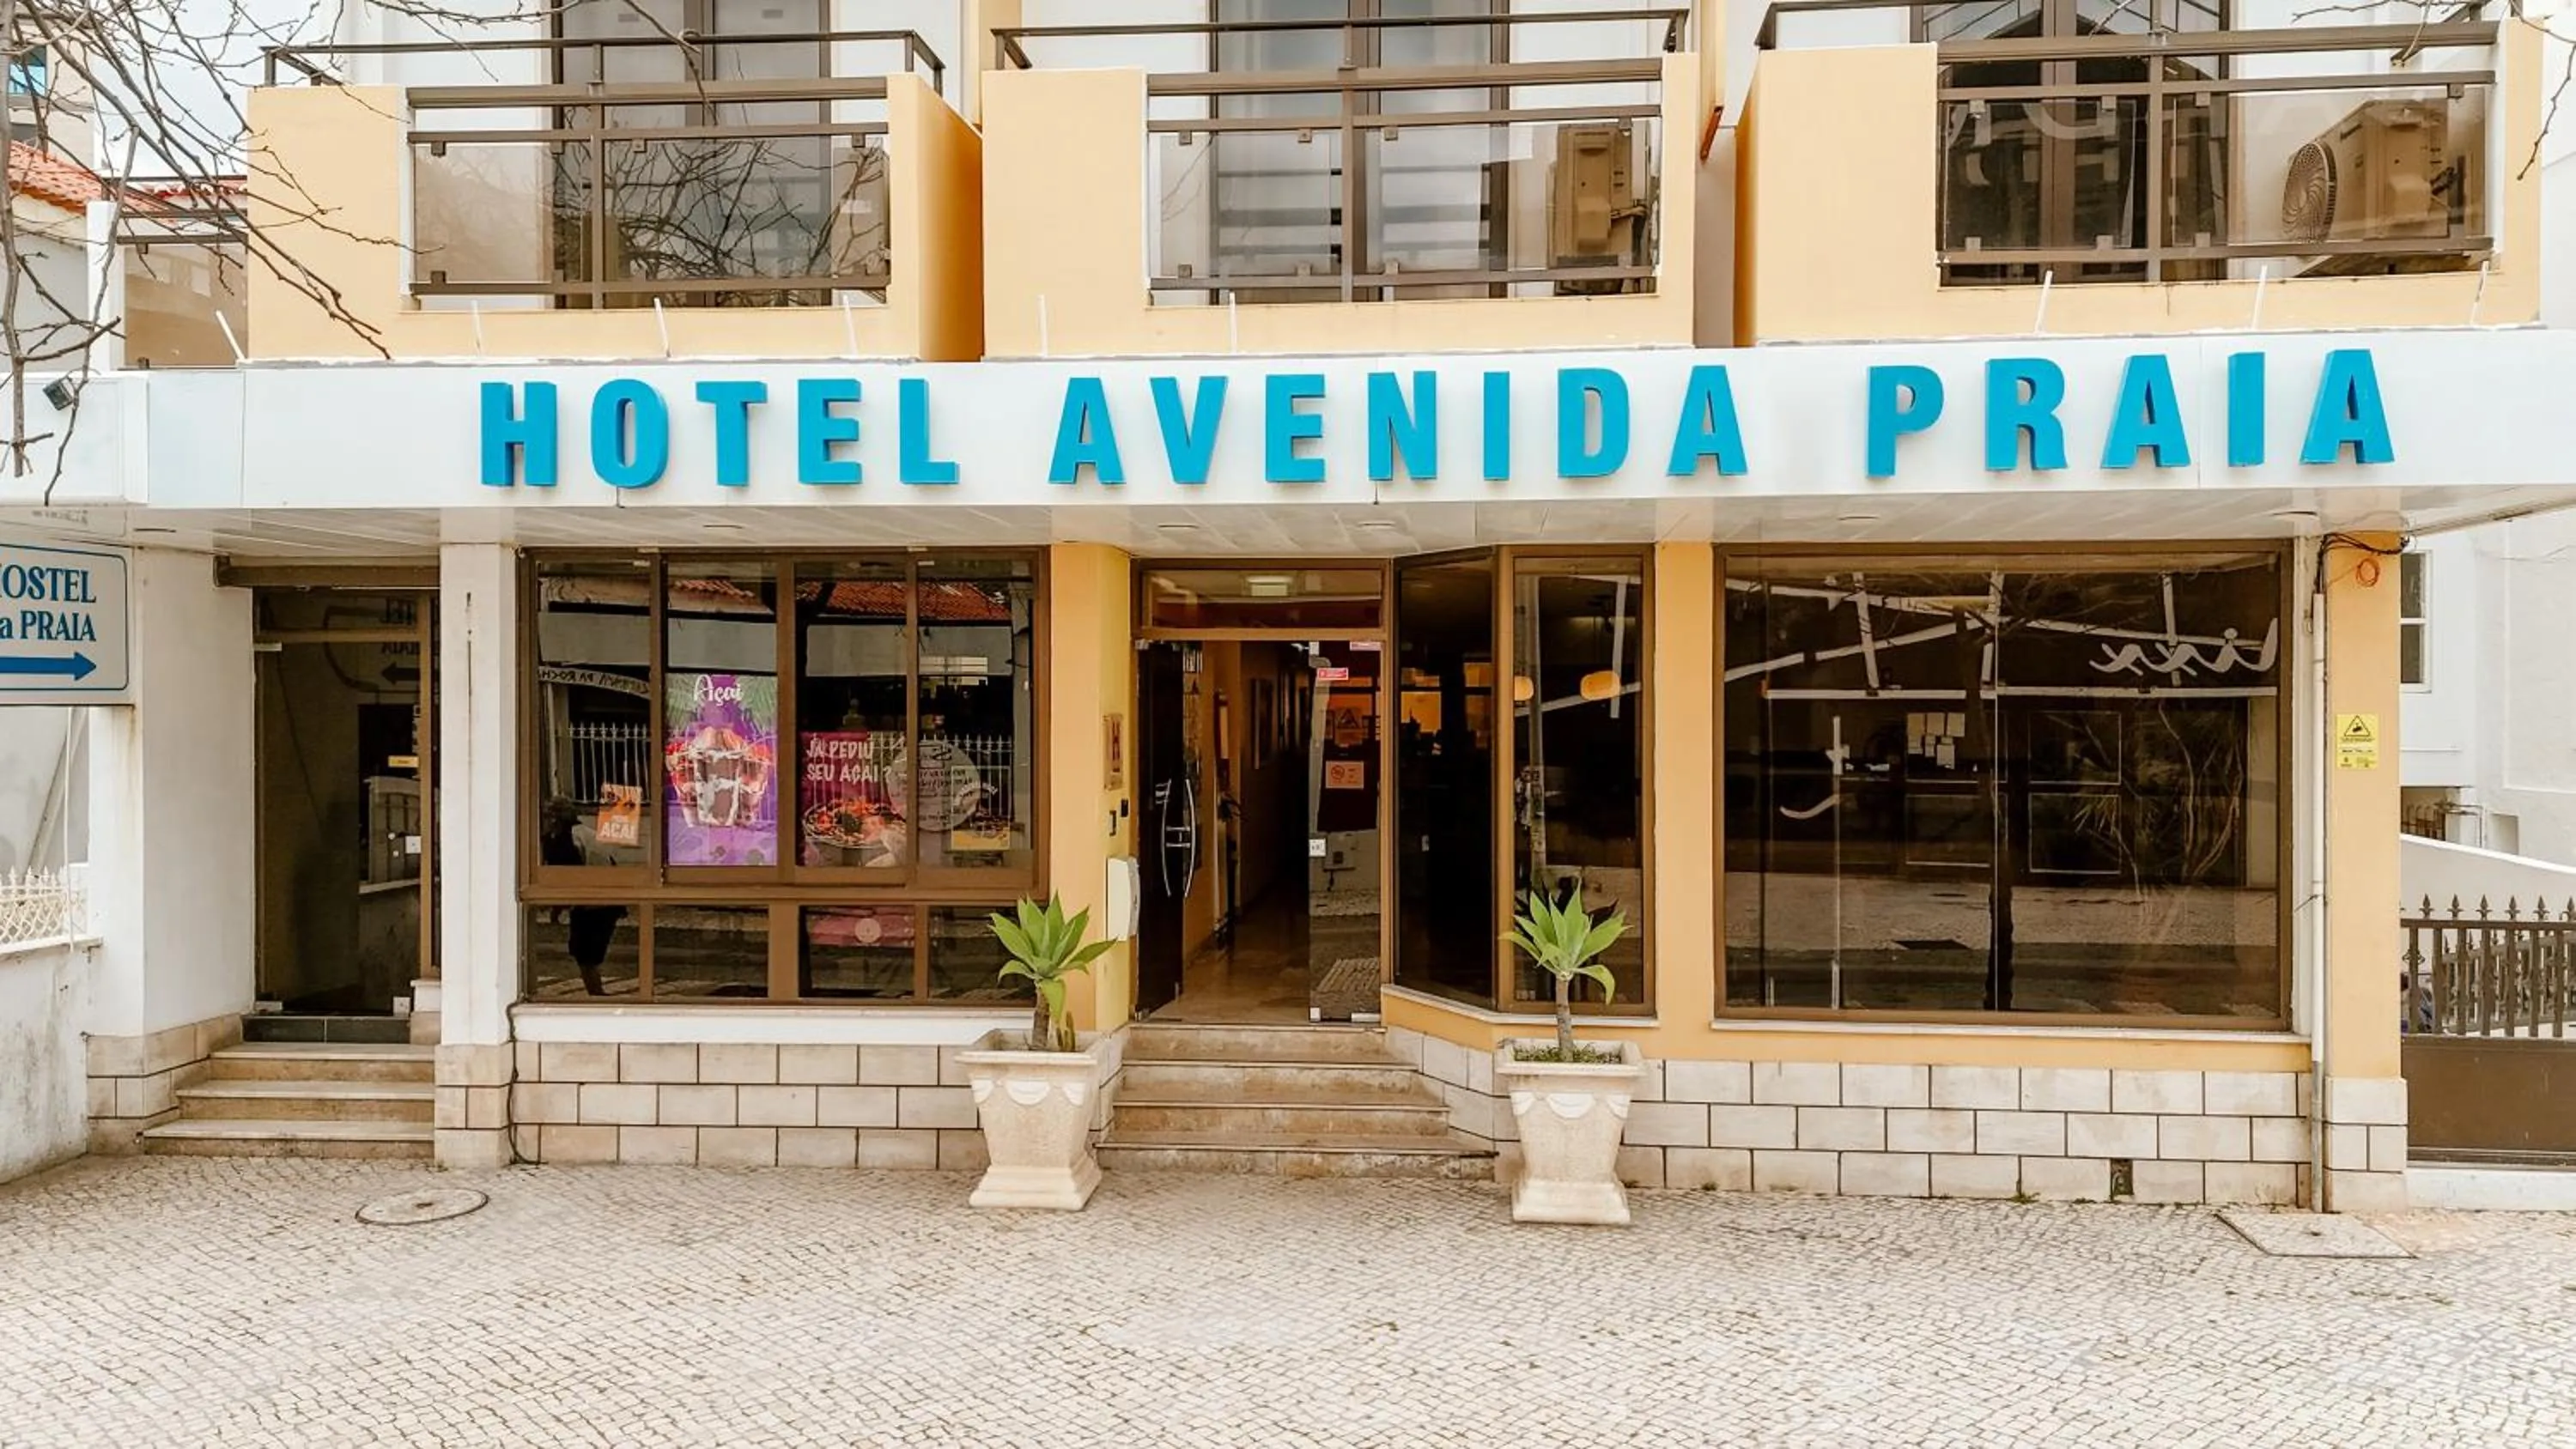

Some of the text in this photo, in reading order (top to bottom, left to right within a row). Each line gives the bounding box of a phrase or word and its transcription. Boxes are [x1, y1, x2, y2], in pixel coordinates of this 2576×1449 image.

[481, 349, 2395, 488] HOTEL AVENIDA PRAIA
[0, 563, 97, 603] OSTEL
[20, 609, 97, 642] PRAIA
[829, 741, 875, 760] PEDIU
[807, 763, 835, 781] SEU
